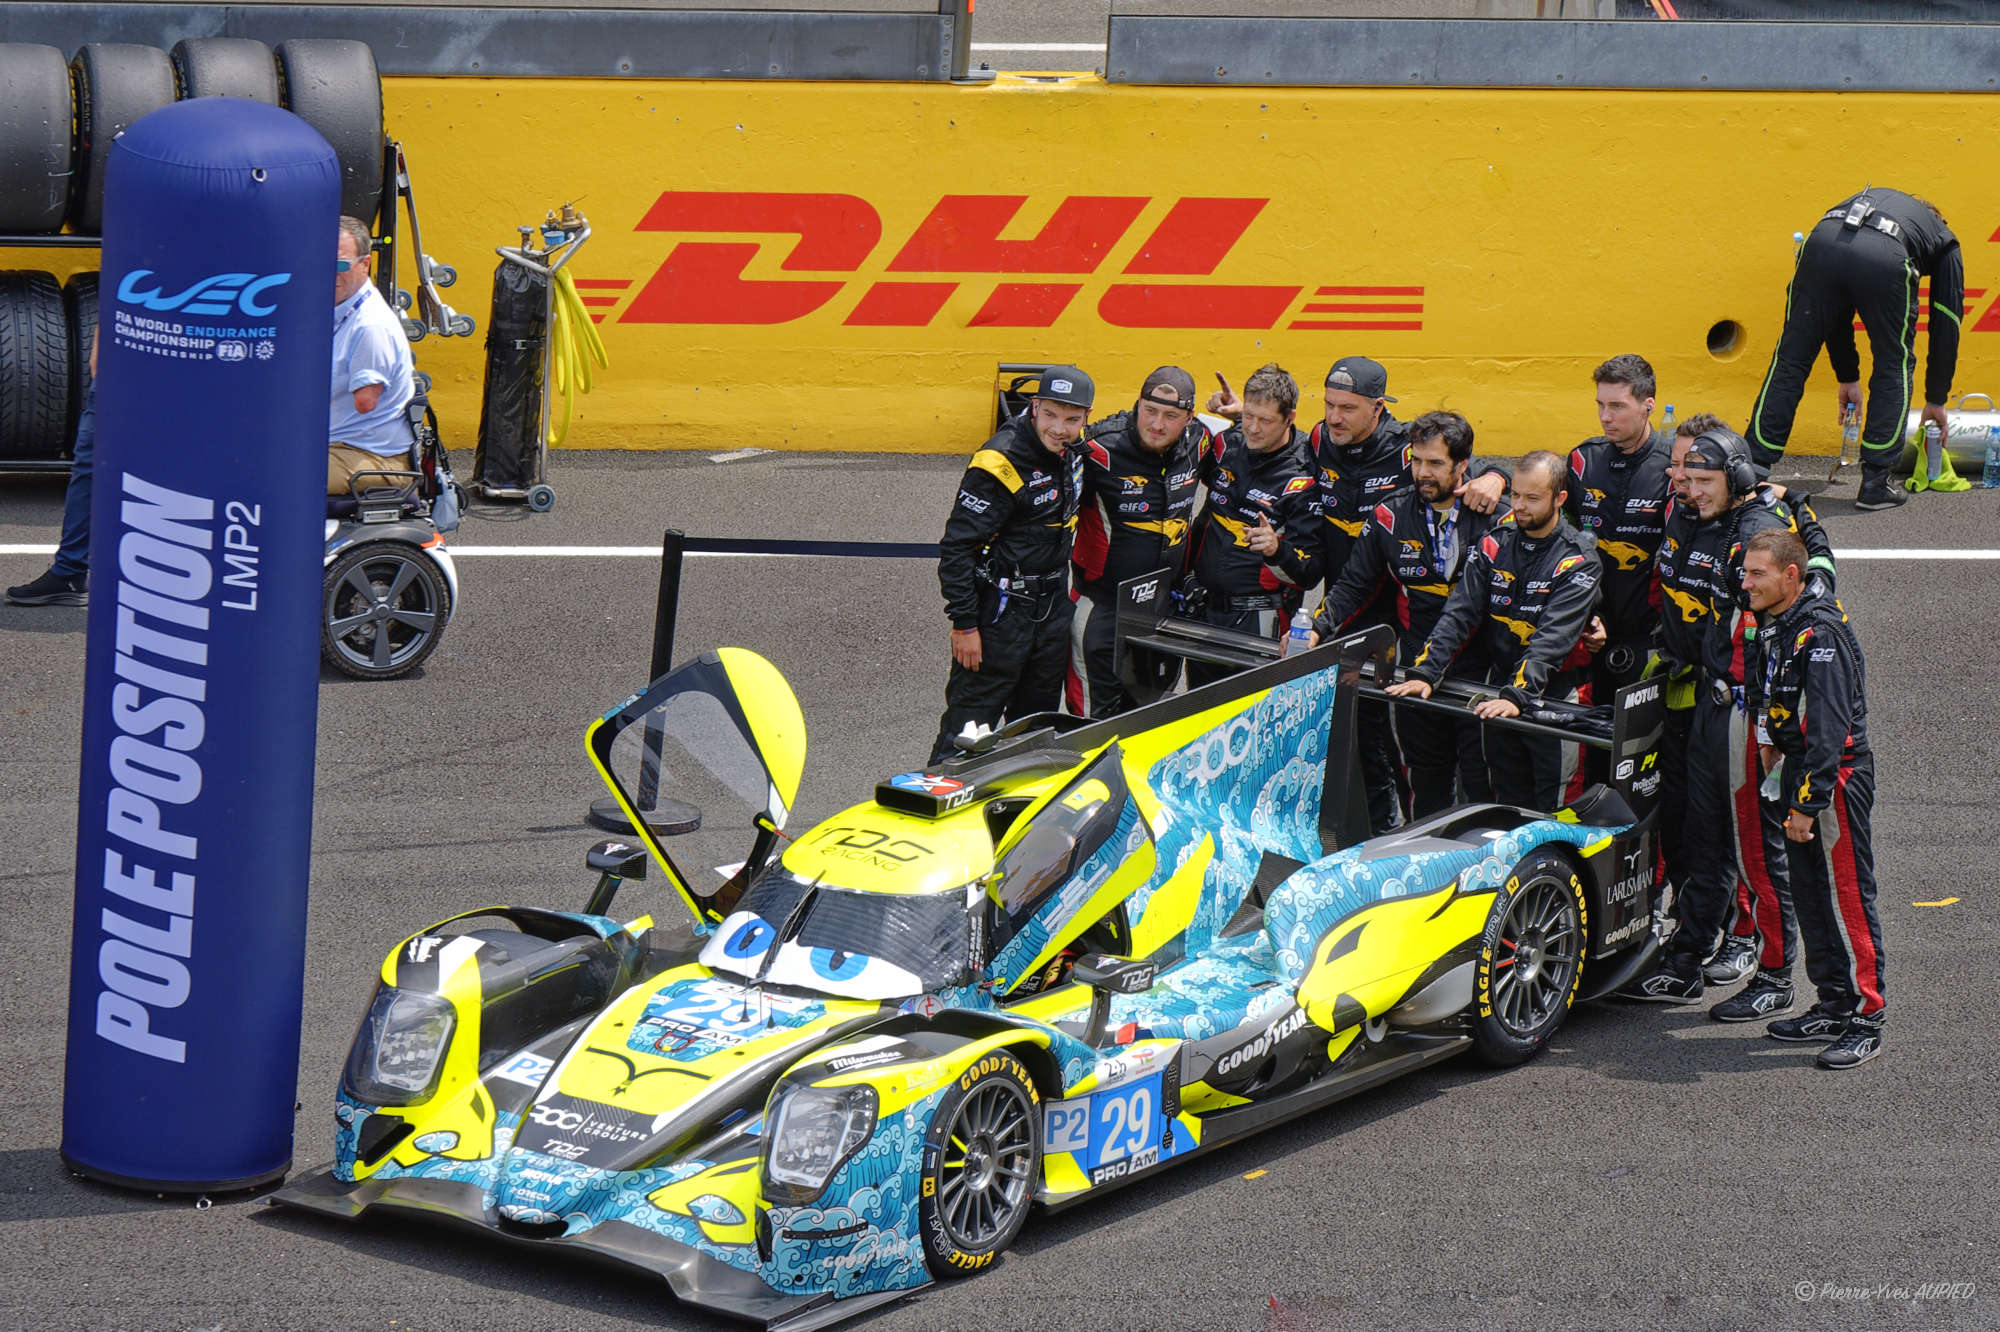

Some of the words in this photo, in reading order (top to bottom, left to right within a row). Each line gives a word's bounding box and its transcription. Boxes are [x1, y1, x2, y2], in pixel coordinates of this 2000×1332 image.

[617, 191, 1304, 330] DHL
[117, 269, 292, 317] WEC
[115, 311, 133, 325] FIA
[133, 315, 184, 335] WORLD
[185, 325, 277, 339] ENDURANCE
[115, 322, 215, 349] CHAMPIONSHIP
[124, 341, 213, 361] PARTNERSHIP
[217, 344, 246, 359] FIA
[958, 489, 992, 511] TDS
[1119, 501, 1140, 512] elf
[1625, 498, 1662, 508] ELMS
[222, 500, 261, 612] LMP2
[1399, 566, 1417, 576] elf
[1131, 579, 1159, 600] TDS
[107, 472, 214, 860] POSITION
[1624, 684, 1660, 711] MOTUL
[944, 785, 976, 811] TDS
[808, 827, 935, 862] TDS
[820, 846, 903, 873] RACING
[1605, 914, 1651, 946] GOODYEAR
[96, 848, 196, 1064] POLE
[1121, 966, 1153, 988] TDS
[1478, 946, 1494, 1018] EAGLE
[662, 993, 772, 1032] 29
[646, 1017, 697, 1033] PRO
[703, 1031, 742, 1045] AM
[1217, 1008, 1307, 1076] GOODYEAR
[506, 1057, 547, 1083] P2
[827, 1051, 904, 1070] Milwaukee
[960, 1055, 1040, 1106] GOODYEAR
[583, 1127, 628, 1143] GROUP
[589, 1120, 648, 1142] VENTURE
[1049, 1105, 1087, 1146] P2
[1100, 1087, 1152, 1163] 29
[543, 1138, 591, 1156] TDS
[1094, 1160, 1128, 1186] PRO
[1133, 1151, 1158, 1171] AM
[948, 1248, 995, 1271] EAGLE
